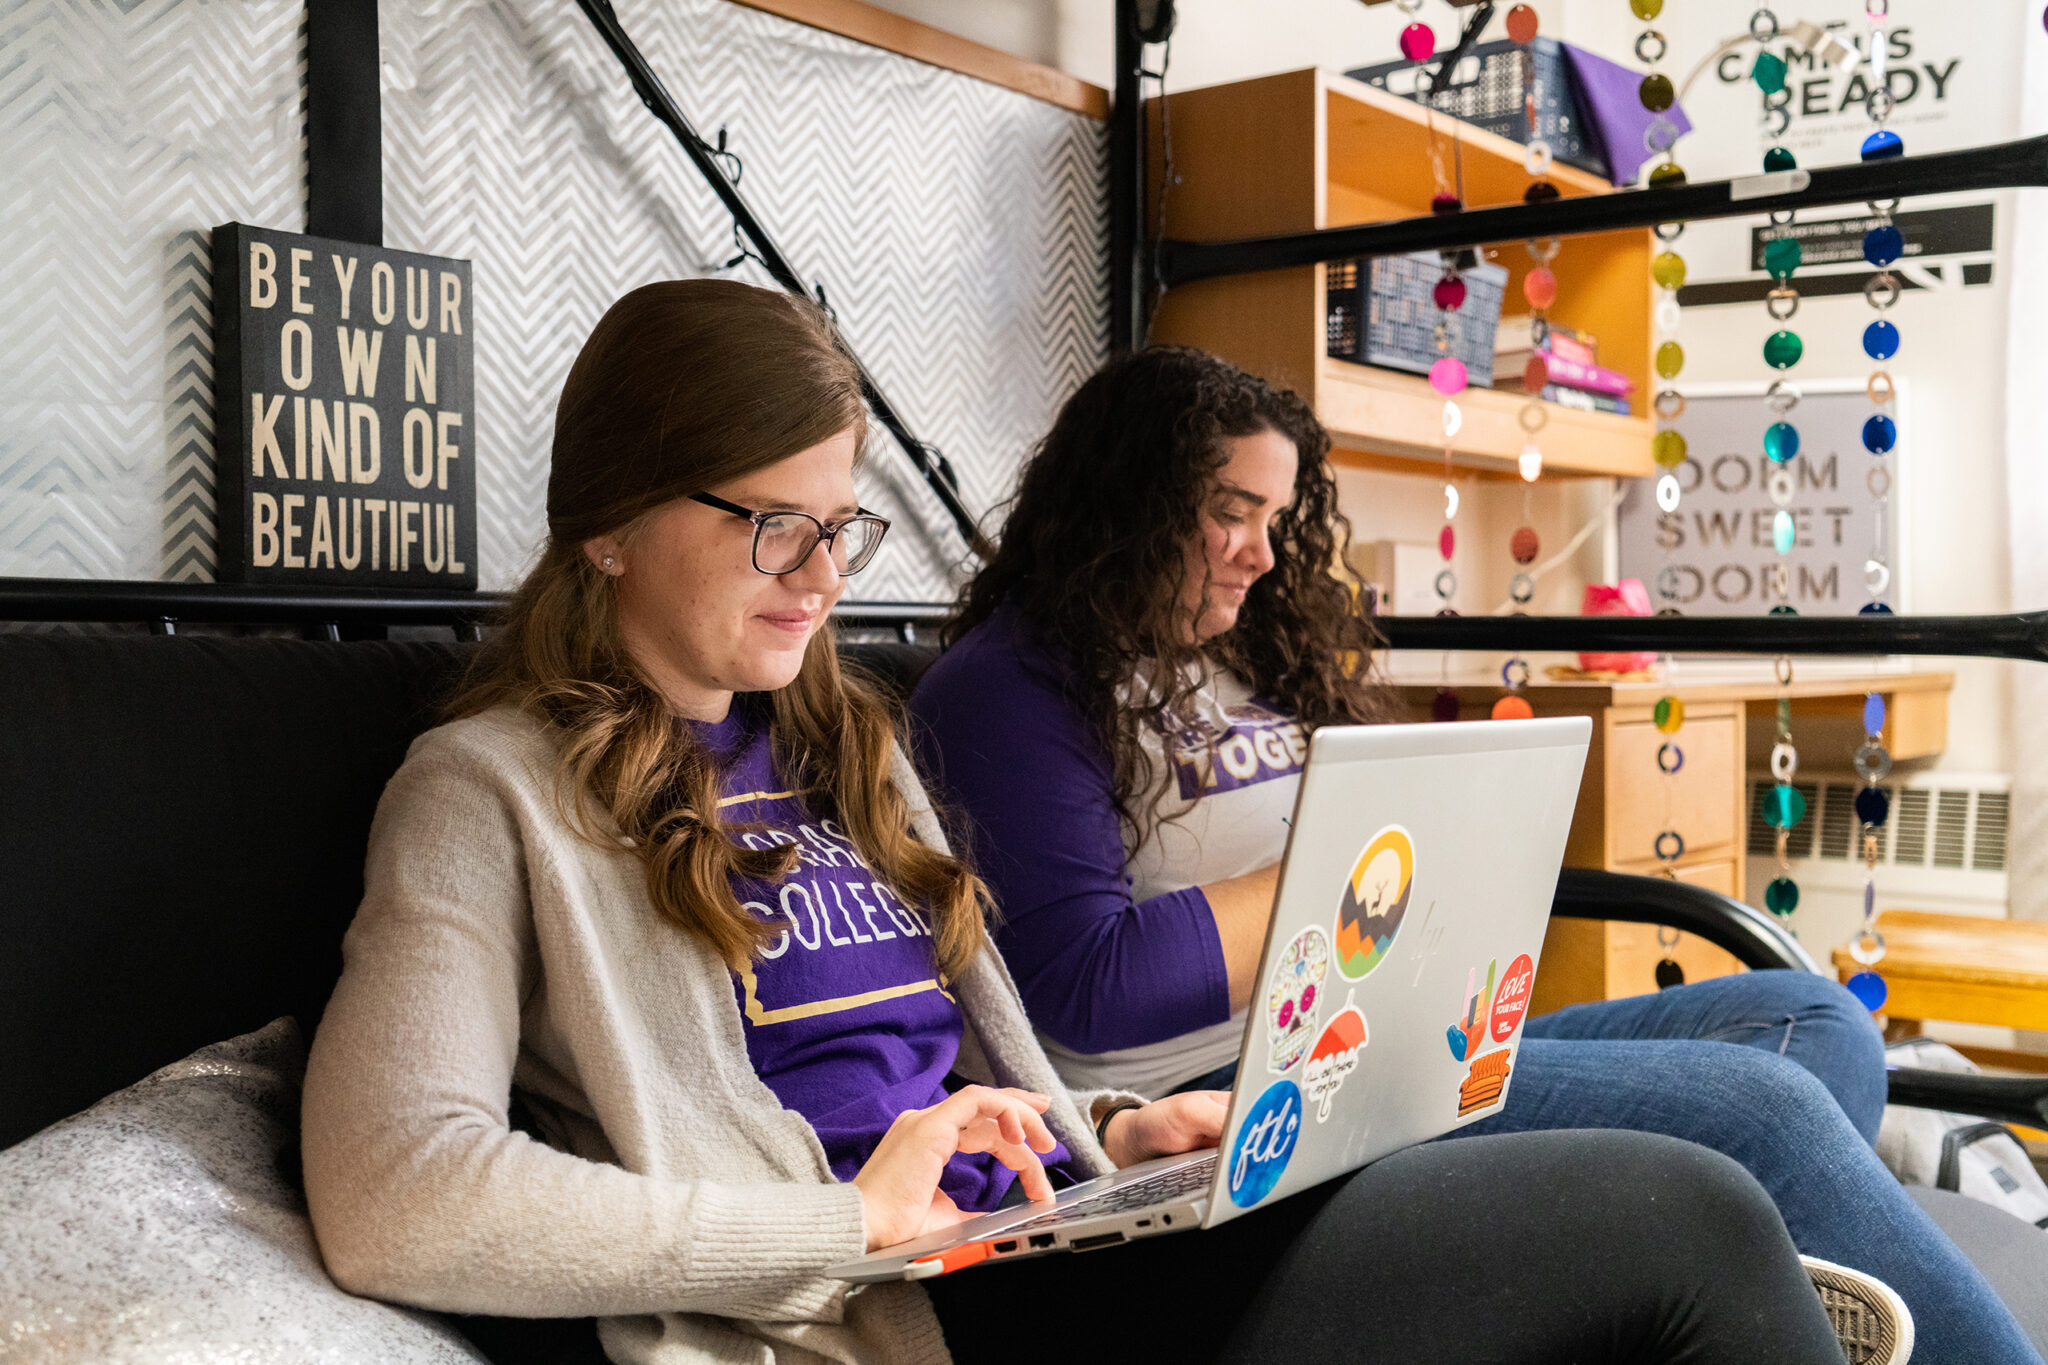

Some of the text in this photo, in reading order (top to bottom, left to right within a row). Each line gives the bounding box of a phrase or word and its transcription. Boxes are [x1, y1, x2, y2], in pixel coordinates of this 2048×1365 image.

[1718, 28, 1913, 82] CMS
[250, 242, 462, 335] BE YOUR
[281, 319, 436, 404] OWN
[252, 393, 462, 490] KIND OF
[252, 492, 465, 574] BEAUTIFUL
[1655, 506, 1852, 550] SWEET
[741, 880, 931, 959] COLLEG
[1496, 971, 1531, 1005] LOVE
